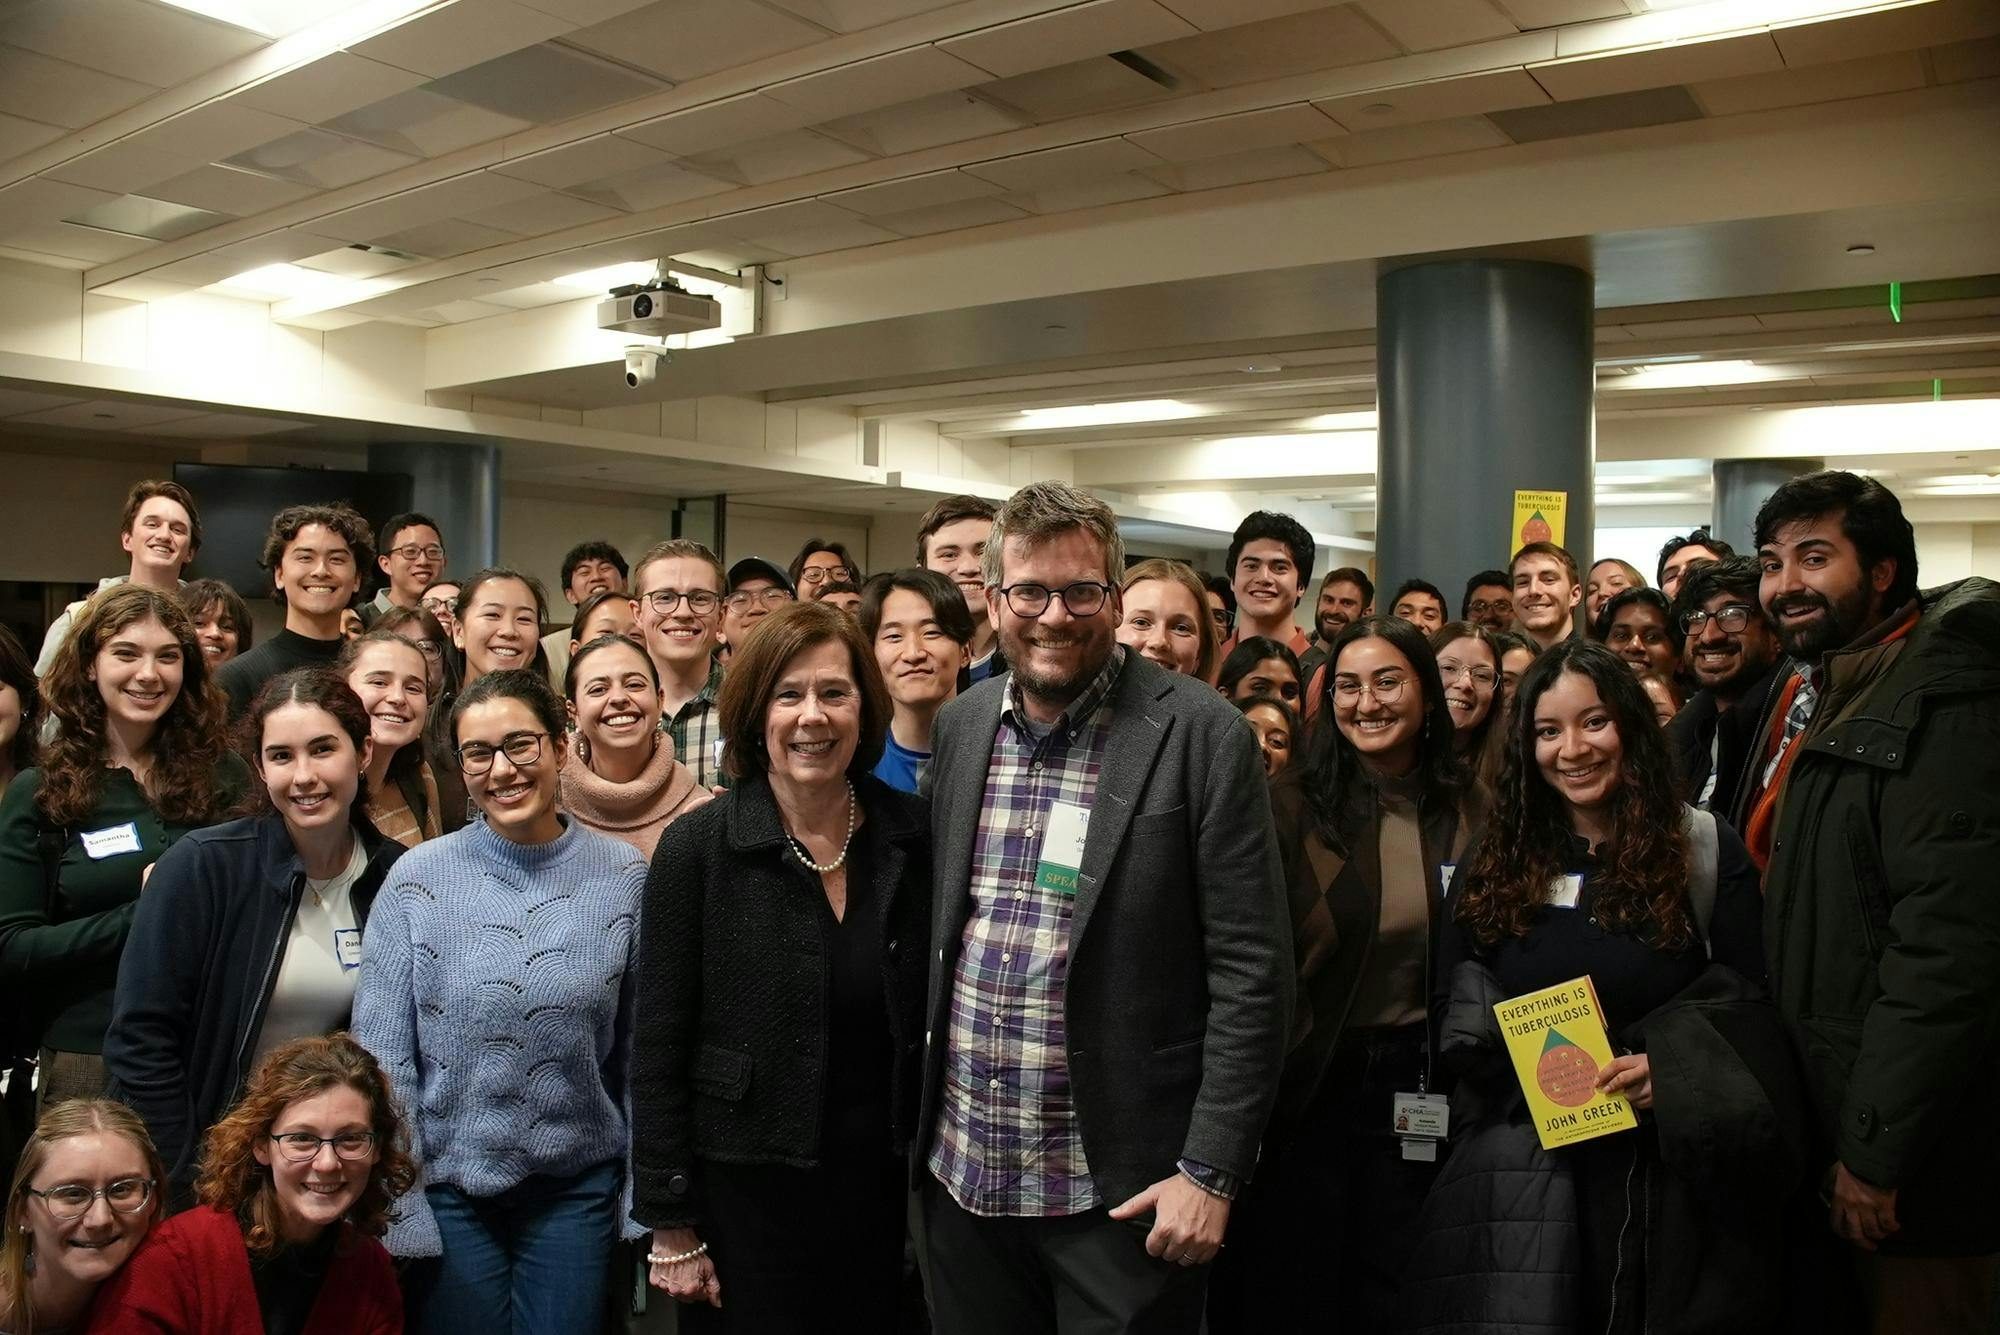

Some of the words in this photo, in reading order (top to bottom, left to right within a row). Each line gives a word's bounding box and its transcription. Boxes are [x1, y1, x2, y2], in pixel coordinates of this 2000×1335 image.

[1517, 494, 1552, 502] EVERYTHING
[1517, 503, 1560, 511] TUBERCULOSIS
[1502, 992, 1569, 1022] EVERYTHING
[1573, 987, 1586, 1000] IS
[1508, 1004, 1591, 1038] TUBERCULOSIS
[1546, 1112, 1578, 1132] JOHN
[1583, 1100, 1624, 1121] GREEN
